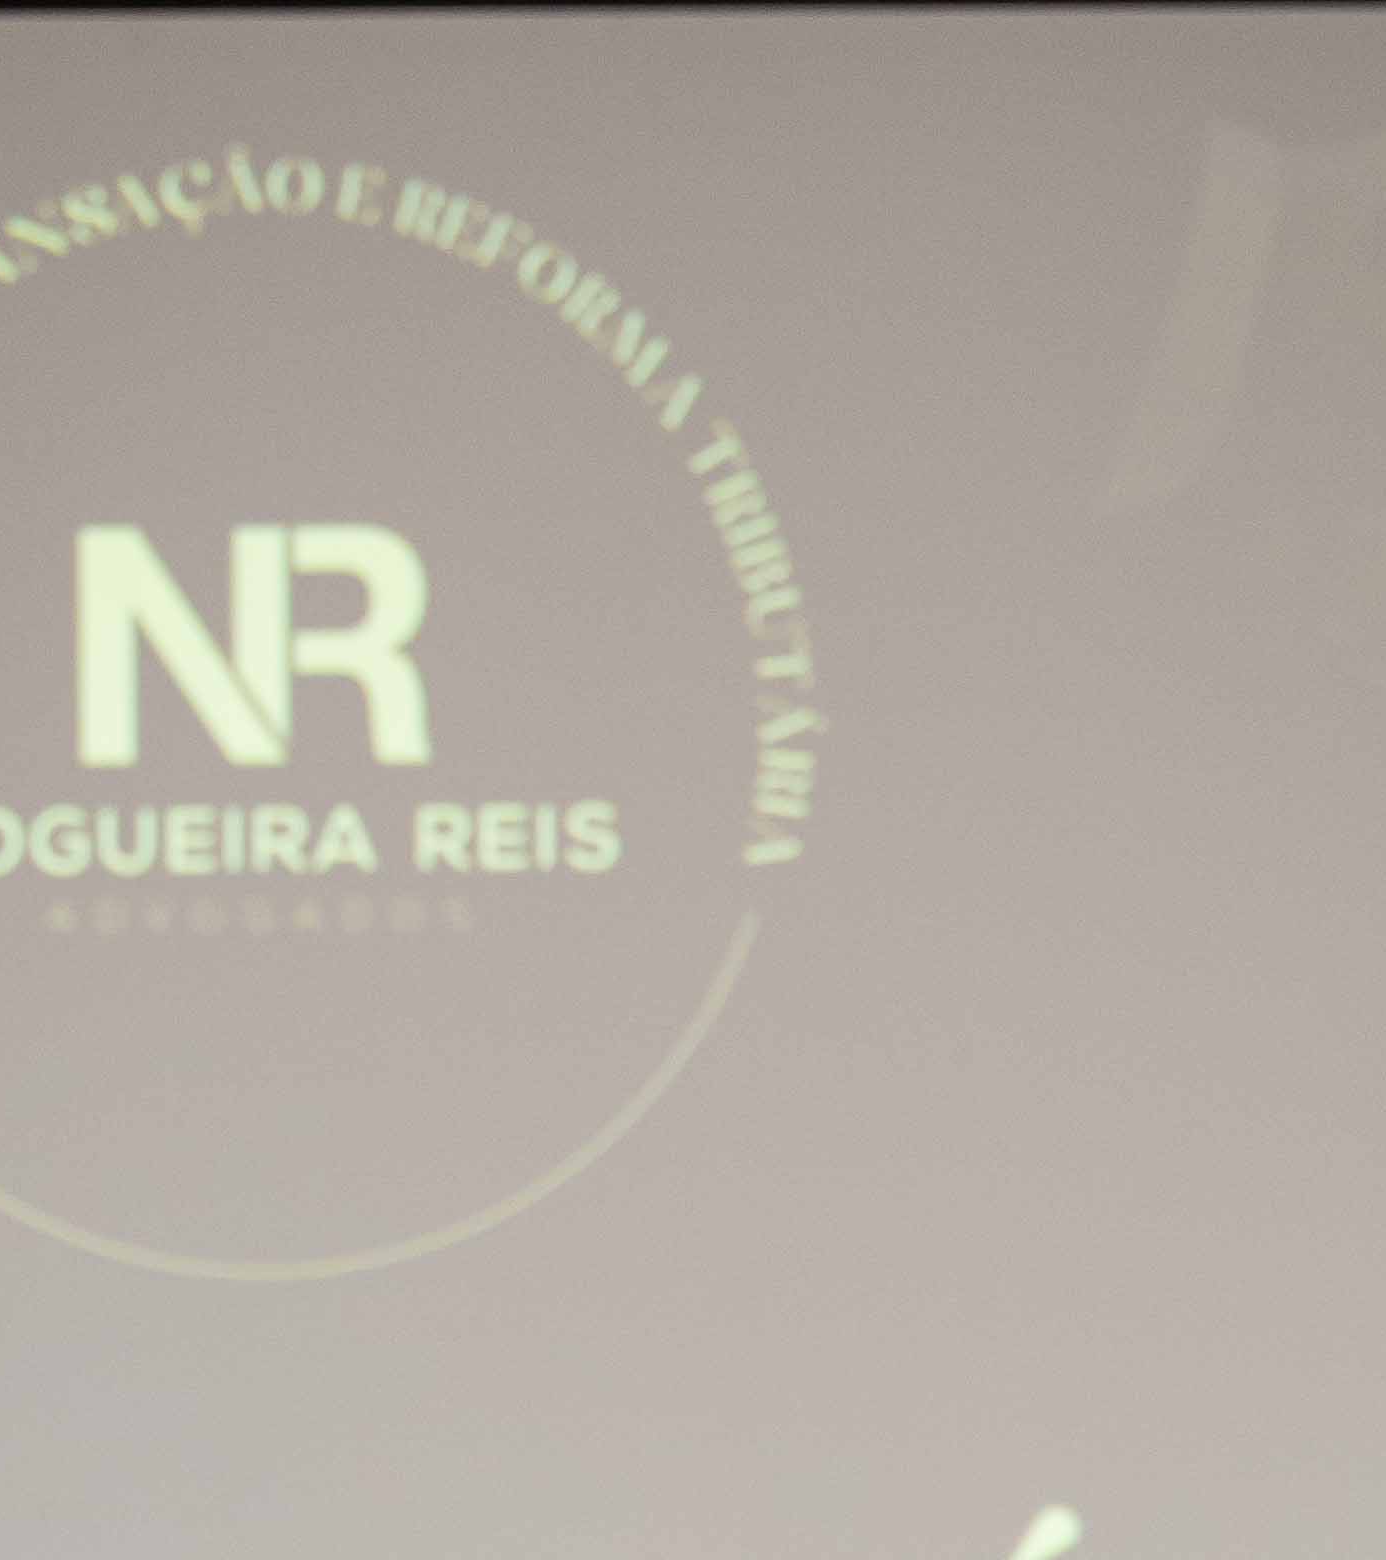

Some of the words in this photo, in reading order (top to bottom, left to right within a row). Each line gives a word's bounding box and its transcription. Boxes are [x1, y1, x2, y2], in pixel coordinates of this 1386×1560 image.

[335, 162, 388, 227] E
[393, 177, 703, 432] REFORMA
[687, 416, 830, 867] TRIBUTÁRIA
[74, 522, 434, 770] NR
[412, 798, 624, 876] REIS
